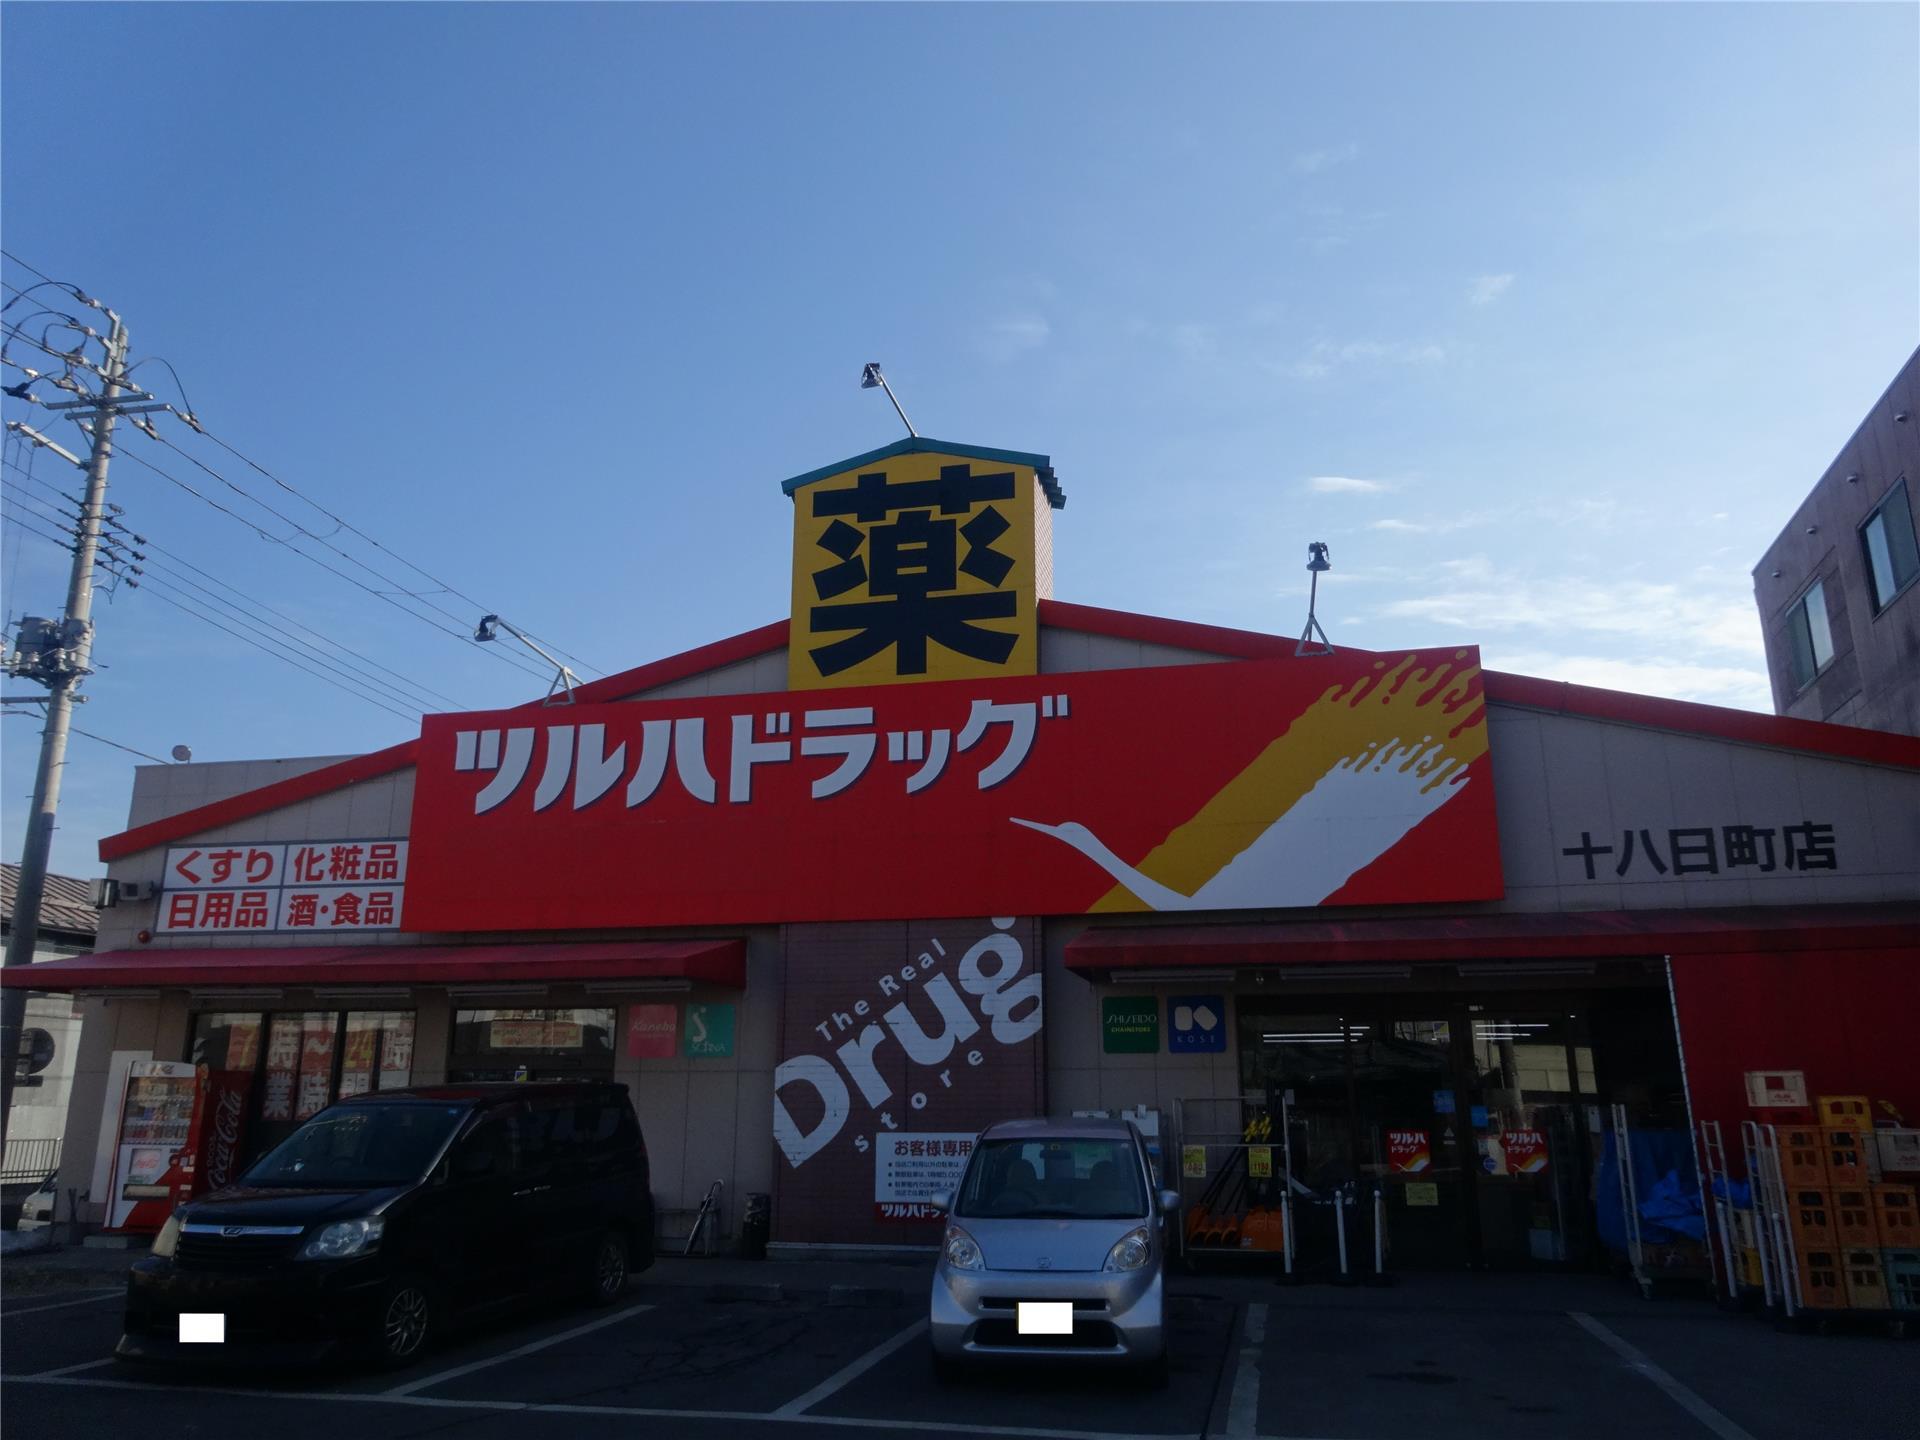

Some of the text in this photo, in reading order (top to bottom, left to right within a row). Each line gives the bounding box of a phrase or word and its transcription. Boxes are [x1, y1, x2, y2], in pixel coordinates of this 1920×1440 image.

[808, 464, 1019, 677] 薬
[455, 694, 1069, 815] ツルハドラッグ
[175, 849, 274, 884] くすり
[294, 844, 398, 882] 化粧品
[1562, 821, 1838, 880] 十八日町店
[168, 892, 268, 928] 日用品
[286, 892, 395, 927] 酒・食品
[815, 937, 947, 1041] The Real
[632, 1020, 677, 1033] Kanebo
[773, 916, 1043, 1169] Drug
[1389, 1132, 1427, 1145] ツルハ
[1505, 1132, 1544, 1145] ツルハ
[881, 1203, 950, 1219] ツルハドラ
